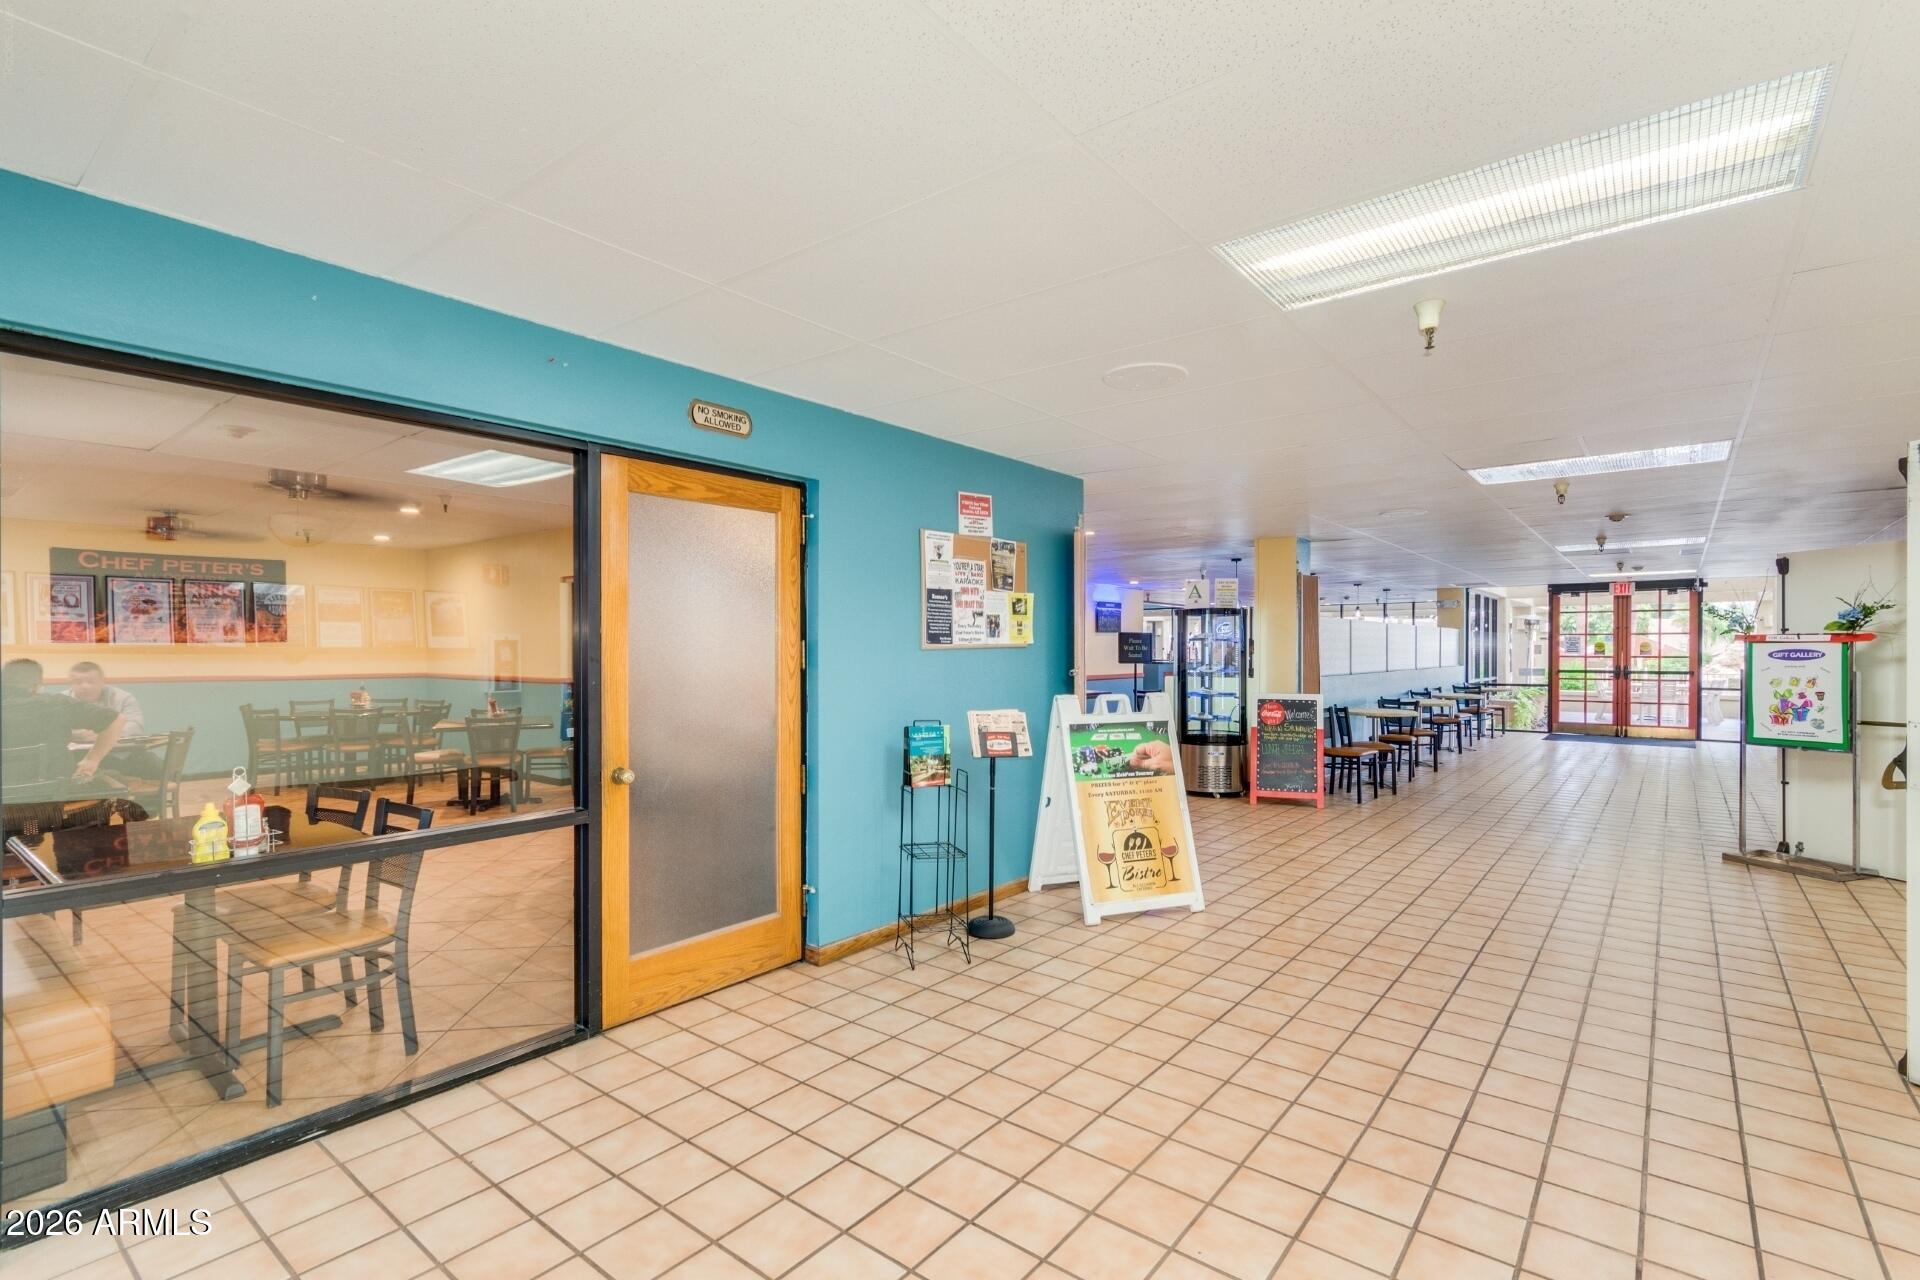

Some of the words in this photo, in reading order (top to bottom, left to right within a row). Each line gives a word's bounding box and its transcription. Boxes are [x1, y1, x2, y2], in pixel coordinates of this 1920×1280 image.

[697, 405, 710, 415] NO
[711, 408, 747, 425] SMOKING
[703, 416, 742, 431] ALLOWED
[78, 551, 155, 571] CHEF
[162, 560, 265, 576] PETER'S
[954, 577, 985, 585] KARAOKE
[1188, 584, 1202, 599] A
[1613, 583, 1631, 595] EXIT
[1121, 851, 1135, 860] CHEF
[1122, 866, 1162, 881] Bistro
